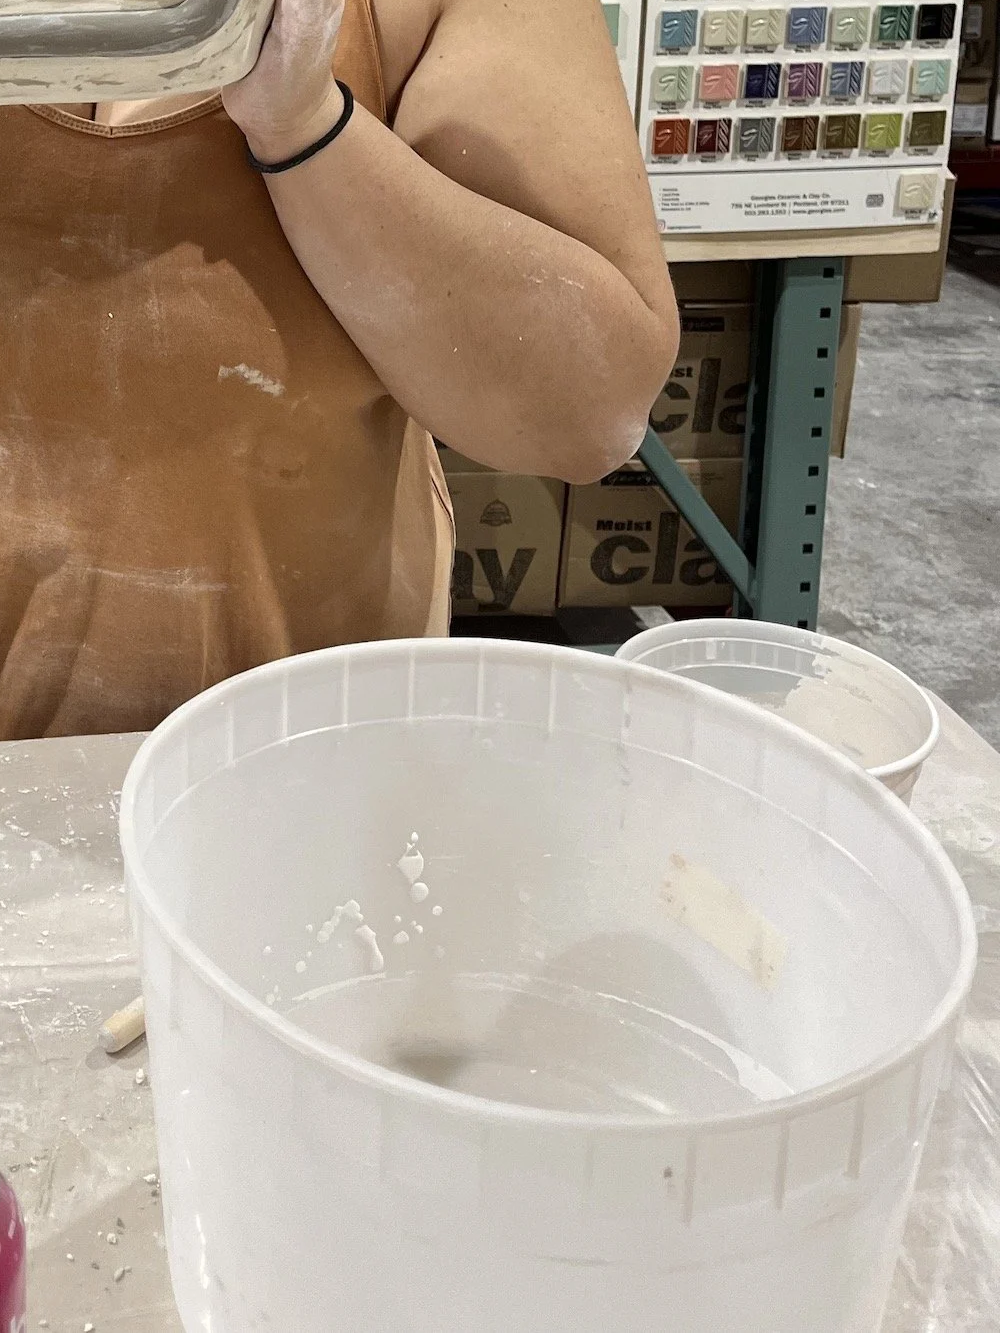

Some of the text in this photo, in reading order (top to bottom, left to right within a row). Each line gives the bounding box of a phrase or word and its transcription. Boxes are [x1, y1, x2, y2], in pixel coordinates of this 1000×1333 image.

[648, 357, 751, 435] cla
[590, 511, 735, 586] cla
[596, 518, 653, 532] Moist
